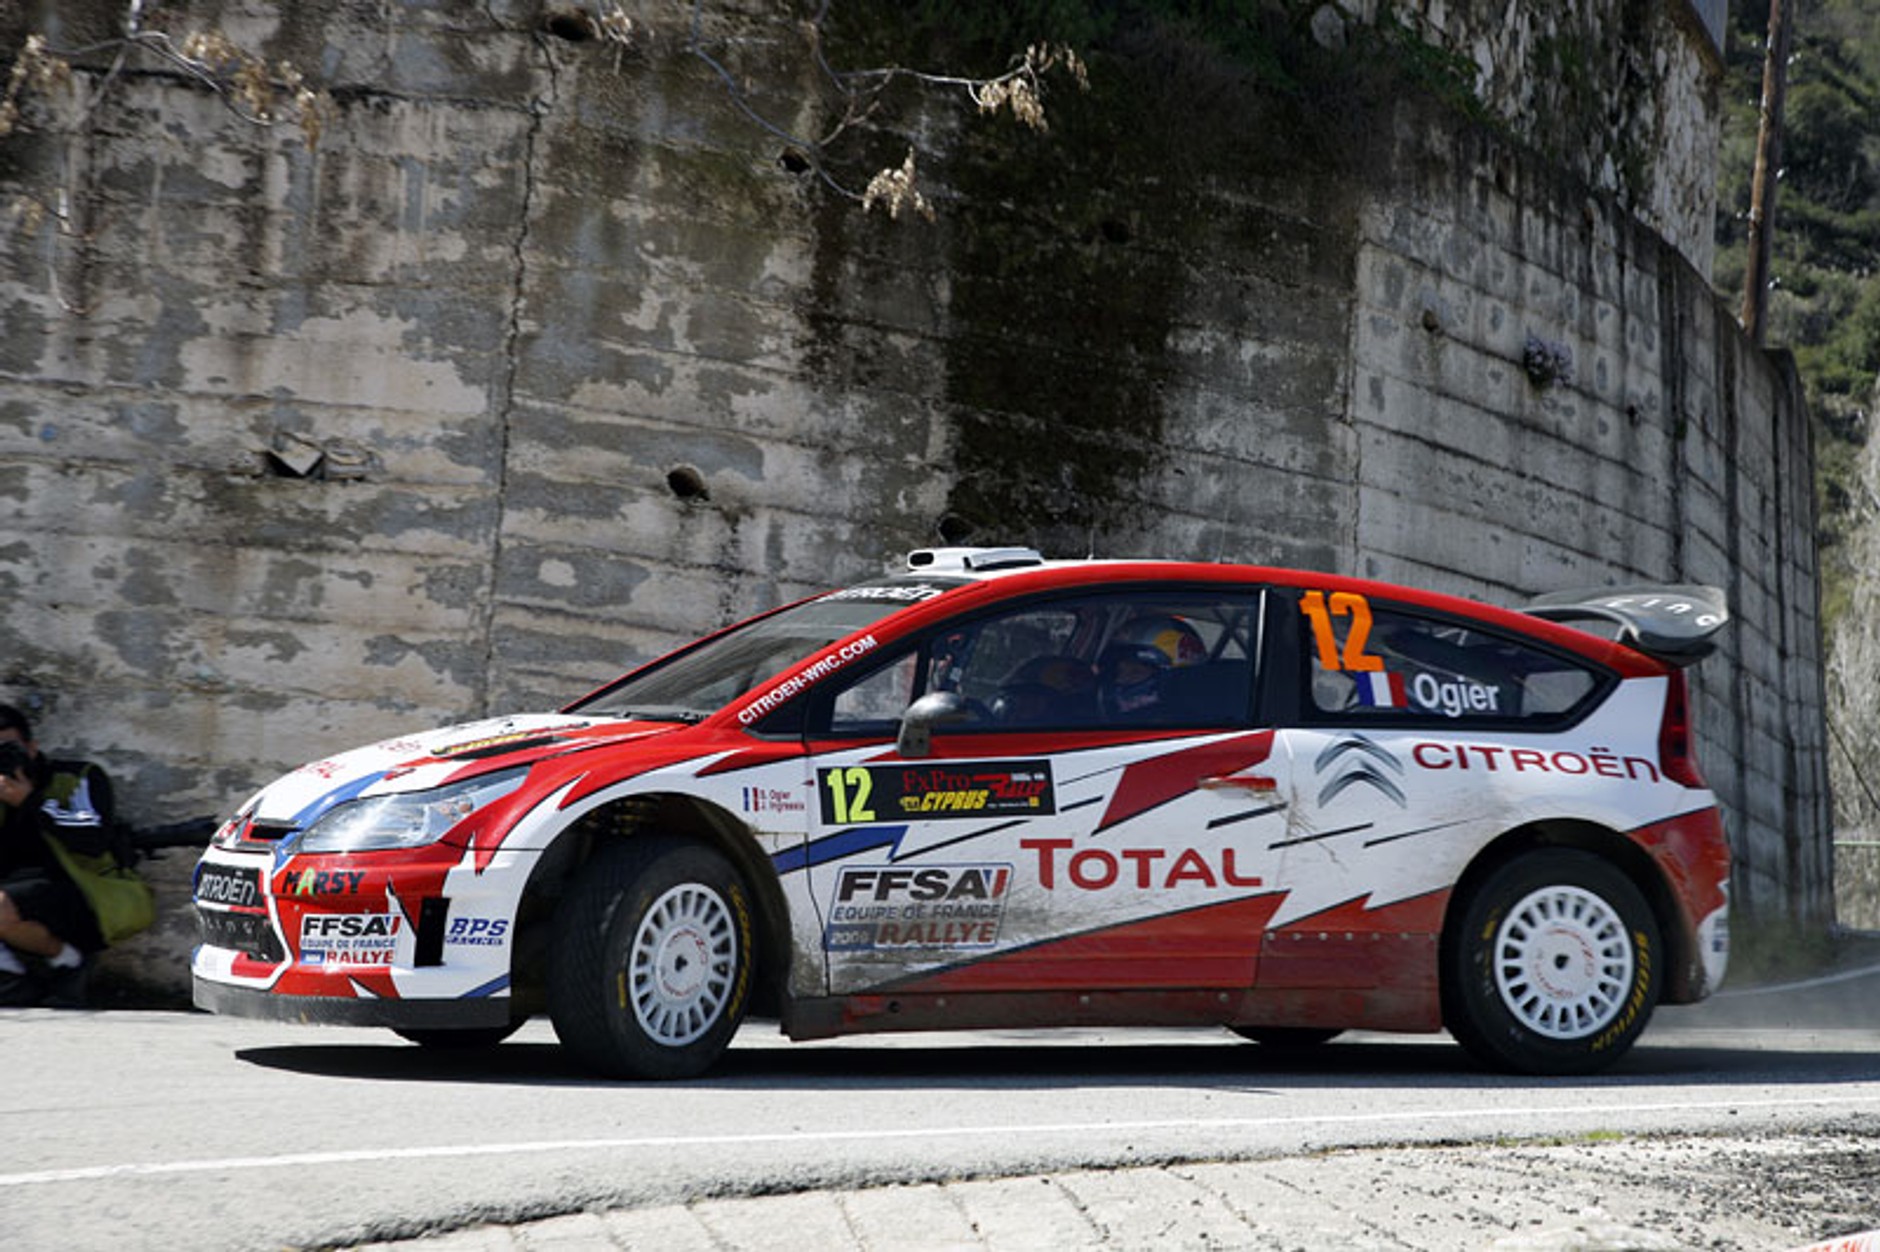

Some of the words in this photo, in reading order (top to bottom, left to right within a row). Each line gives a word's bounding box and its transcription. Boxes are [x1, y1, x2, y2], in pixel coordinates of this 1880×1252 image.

[1299, 590, 1385, 672] 12
[738, 635, 877, 725] CITROEN-WRC.COM
[1413, 673, 1499, 717] Ogier
[902, 770, 971, 791] FxPro
[827, 767, 876, 824] 12
[921, 790, 989, 811] CYPRUS
[1020, 839, 1262, 890] TOTAL
[282, 867, 366, 897] MARSY
[839, 869, 988, 901] FFSA
[903, 905, 928, 919] DE
[931, 904, 1002, 919] FRANCE
[303, 916, 389, 936] FFSA
[449, 918, 509, 936] BPS
[876, 922, 997, 945] RALLYE
[353, 938, 396, 948] FRANCE
[327, 950, 395, 964] RALLYE
